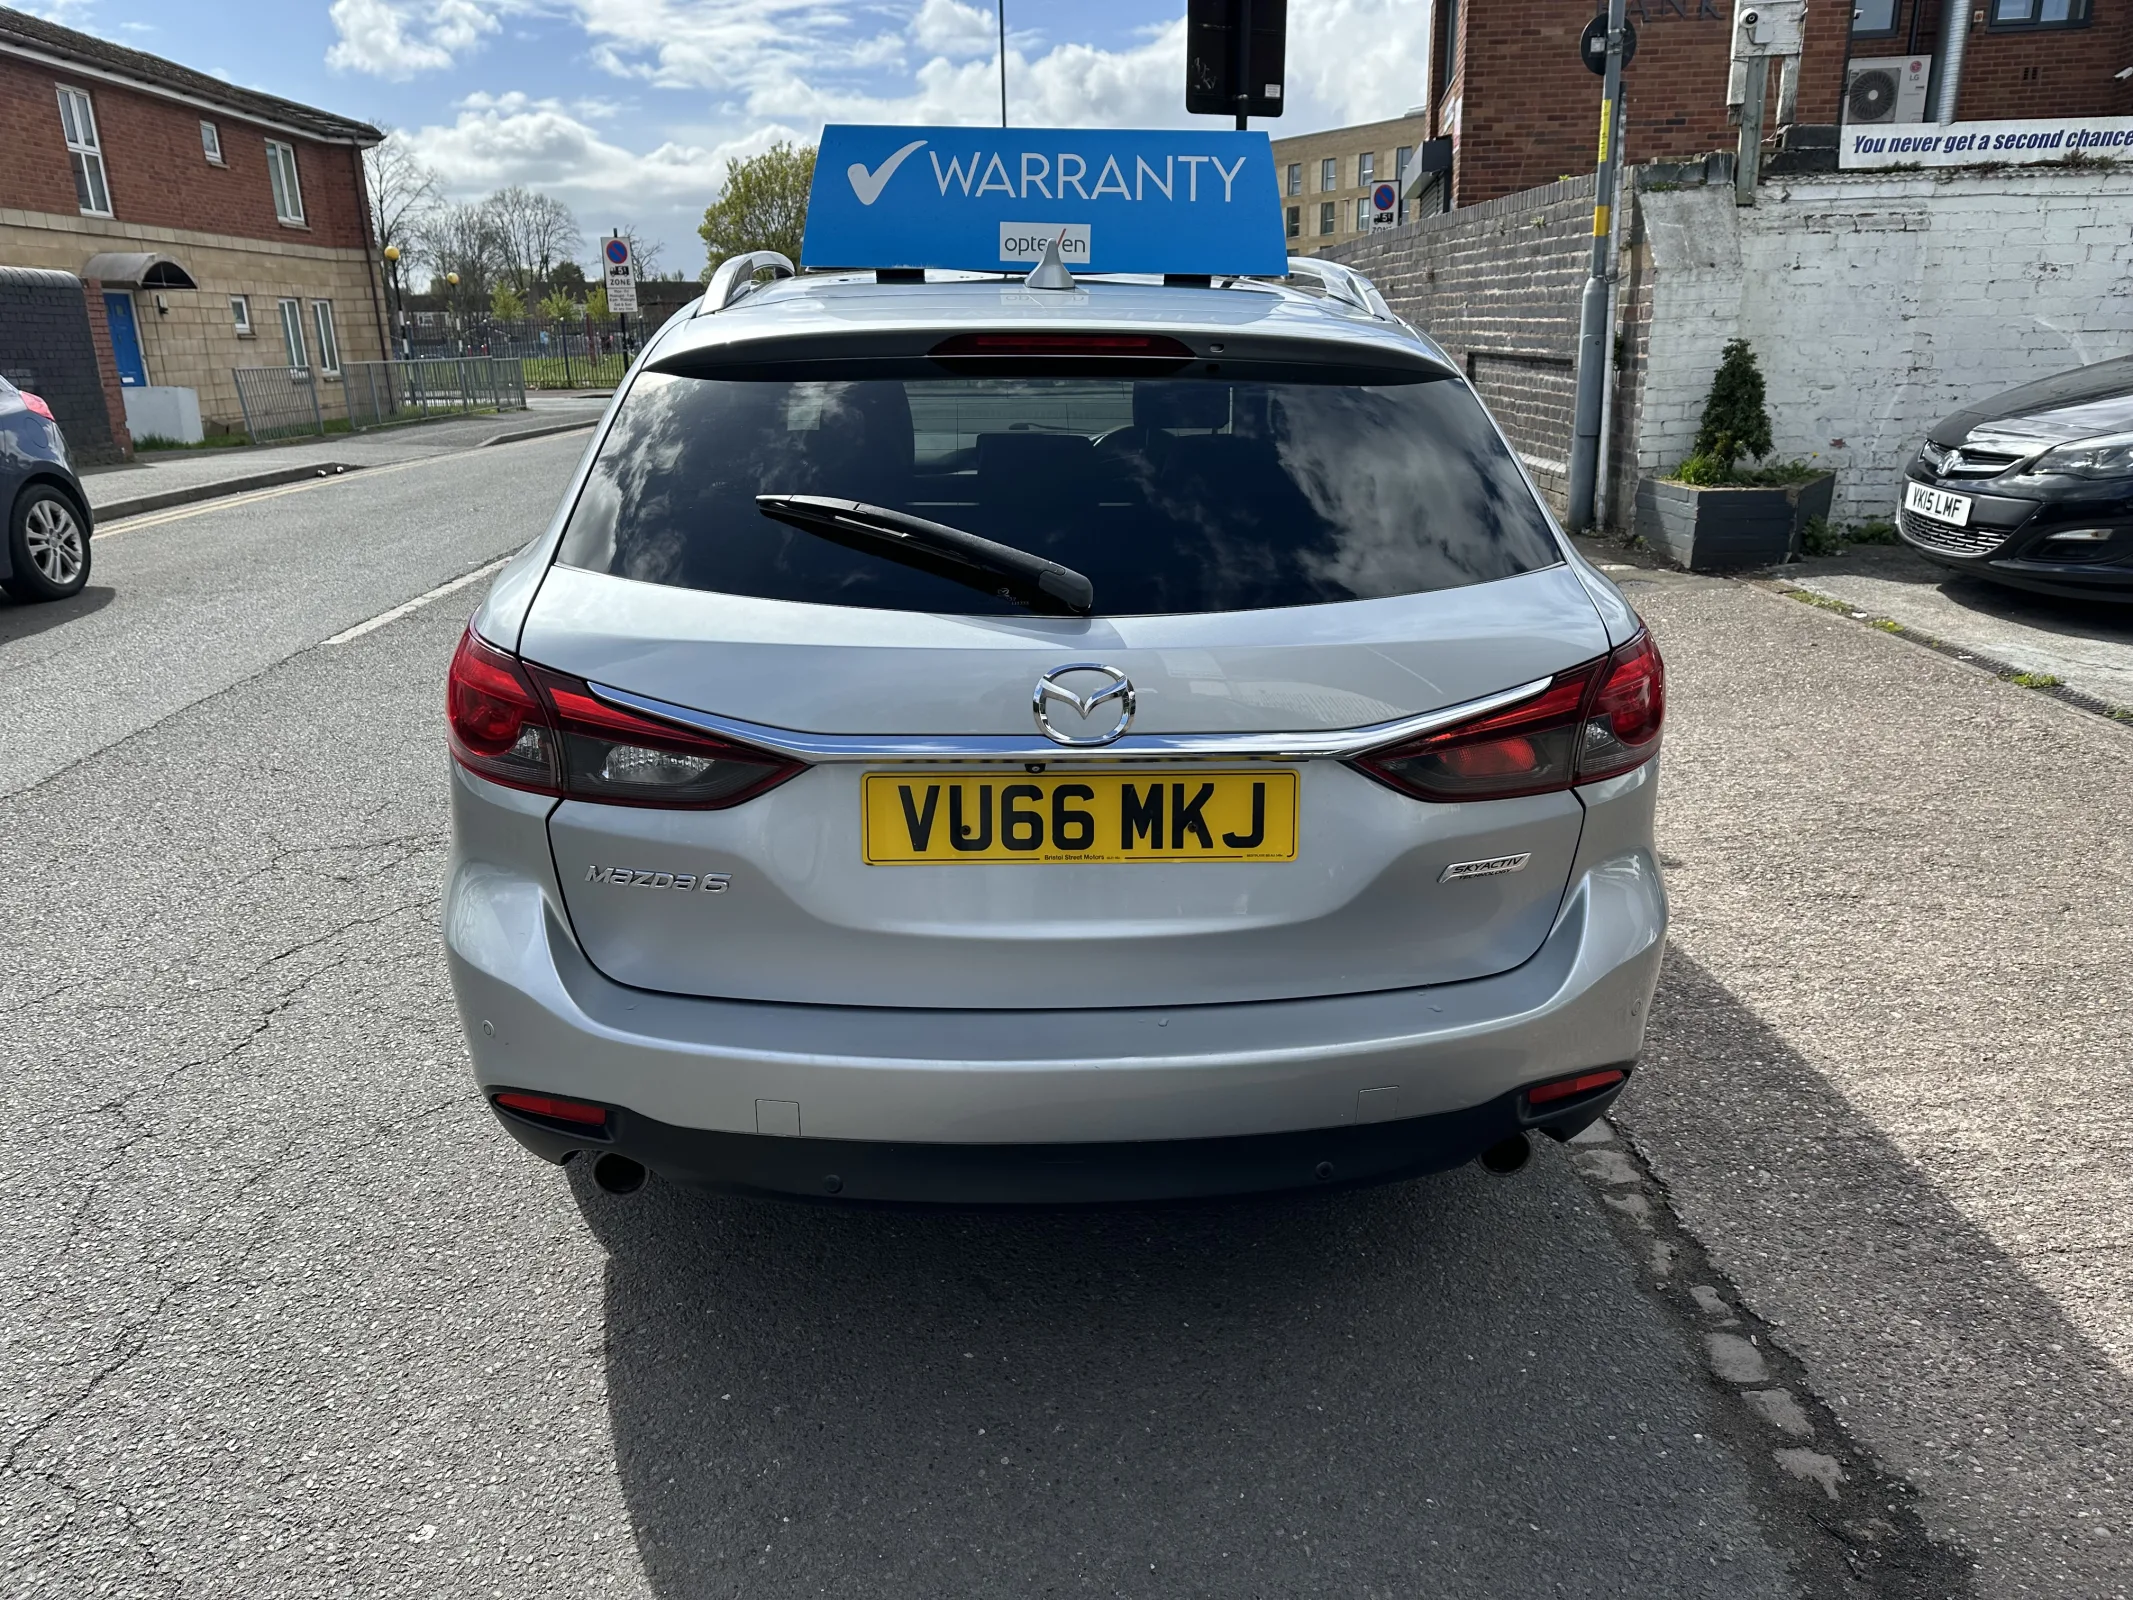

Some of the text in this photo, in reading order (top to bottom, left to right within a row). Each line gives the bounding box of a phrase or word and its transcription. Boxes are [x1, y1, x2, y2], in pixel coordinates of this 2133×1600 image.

[1853, 128, 2133, 154] You never get a second chance
[929, 150, 1247, 203] WARRANTY
[1935, 494, 1962, 518] LMF
[897, 782, 1266, 852] VU66 MKJ
[1453, 856, 1524, 874] SKYACTIV
